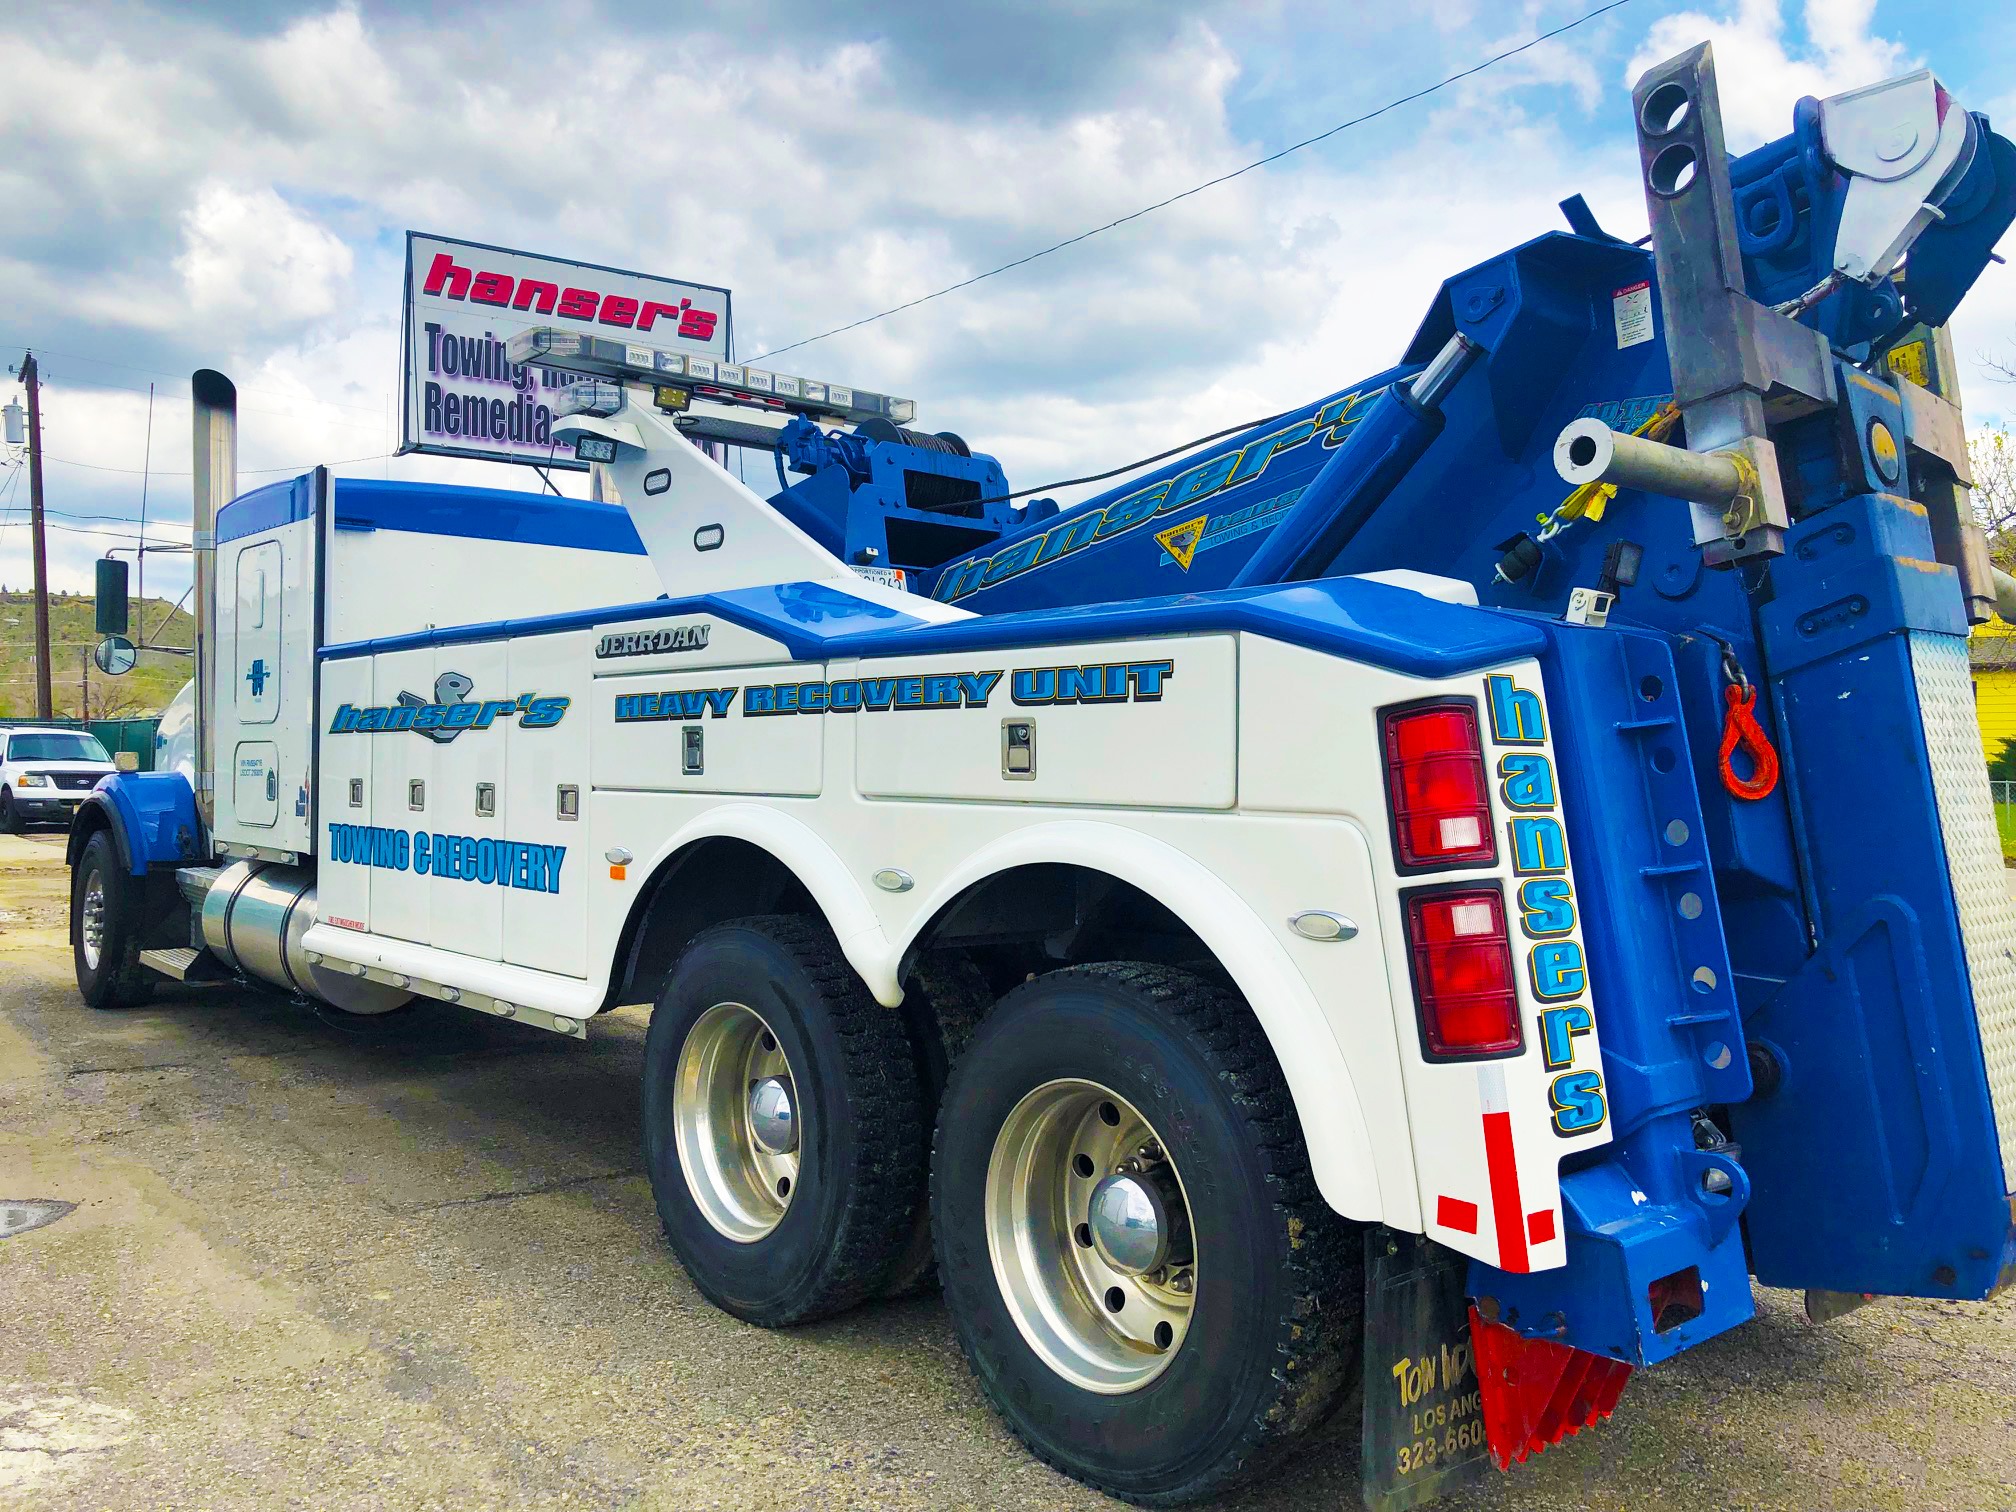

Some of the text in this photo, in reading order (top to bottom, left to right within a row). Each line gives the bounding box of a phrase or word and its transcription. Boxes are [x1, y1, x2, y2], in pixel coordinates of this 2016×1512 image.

[423, 253, 718, 342] hanser's
[424, 381, 572, 449] Remedia
[1209, 523, 1249, 546] TOWING
[1251, 519, 1259, 530] &
[595, 624, 710, 659] JERR-DAN
[329, 692, 571, 735] hanser's
[615, 658, 1174, 723] HEAVY RECOVERY UNIT
[329, 823, 567, 894] TOWING & RECOVERY
[1482, 673, 1608, 1138] hansers
[1413, 1408, 1446, 1435] LOS
